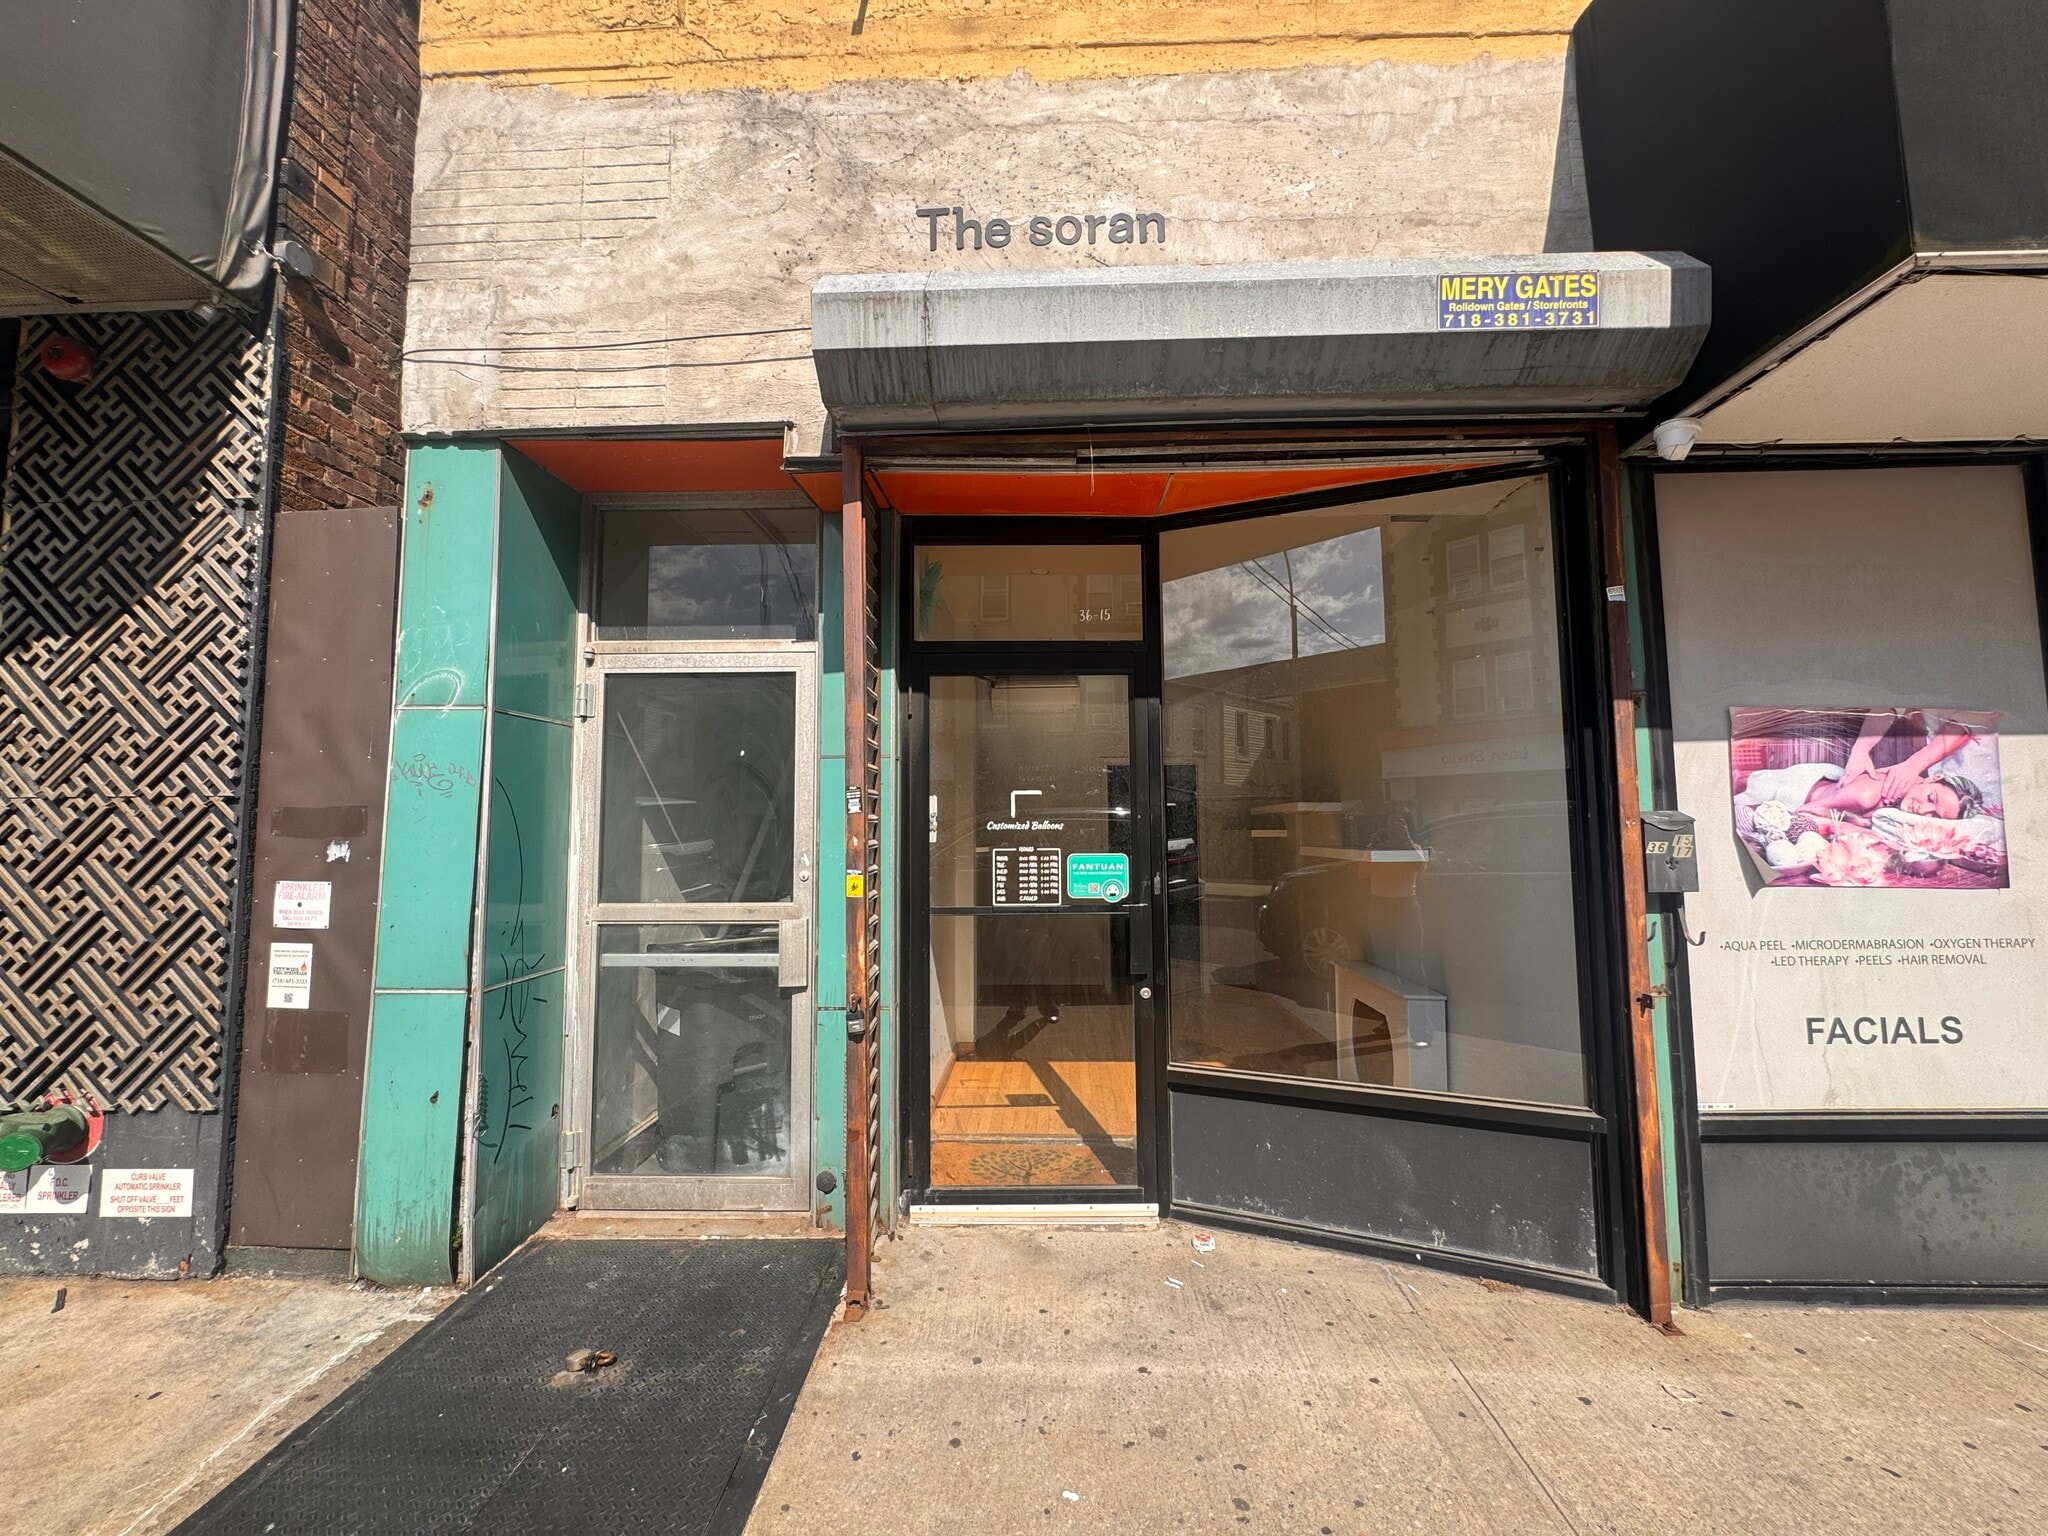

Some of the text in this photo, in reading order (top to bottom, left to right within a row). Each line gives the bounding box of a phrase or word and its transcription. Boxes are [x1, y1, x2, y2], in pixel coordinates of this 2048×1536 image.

[916, 206, 1165, 251] The soran
[1441, 274, 1597, 300] MERY GATES
[1449, 303, 1494, 312] Rolldown
[1497, 302, 1525, 311] Gates
[1533, 300, 1588, 310] Storefronts
[1443, 311, 1595, 327] 718-381-3731
[1079, 608, 1111, 622] 36-15
[987, 820, 1064, 830] Customized Balloons
[1676, 836, 1691, 846] 15
[1648, 843, 1665, 853] 36
[1677, 847, 1692, 857] 17
[281, 883, 325, 892] SPRINKLER
[278, 891, 326, 900] FIRE-ALARM
[1760, 941, 1786, 950] PEEL
[1983, 938, 2035, 949] THERAPY
[1798, 955, 1849, 966] THERAPY
[1932, 954, 1987, 965] REMOVAL
[1806, 1016, 1963, 1045] FACIALS
[131, 1173, 148, 1181] CURB
[115, 1183, 148, 1191] AUTOMATIC
[37, 1191, 79, 1200] SPRINKLER
